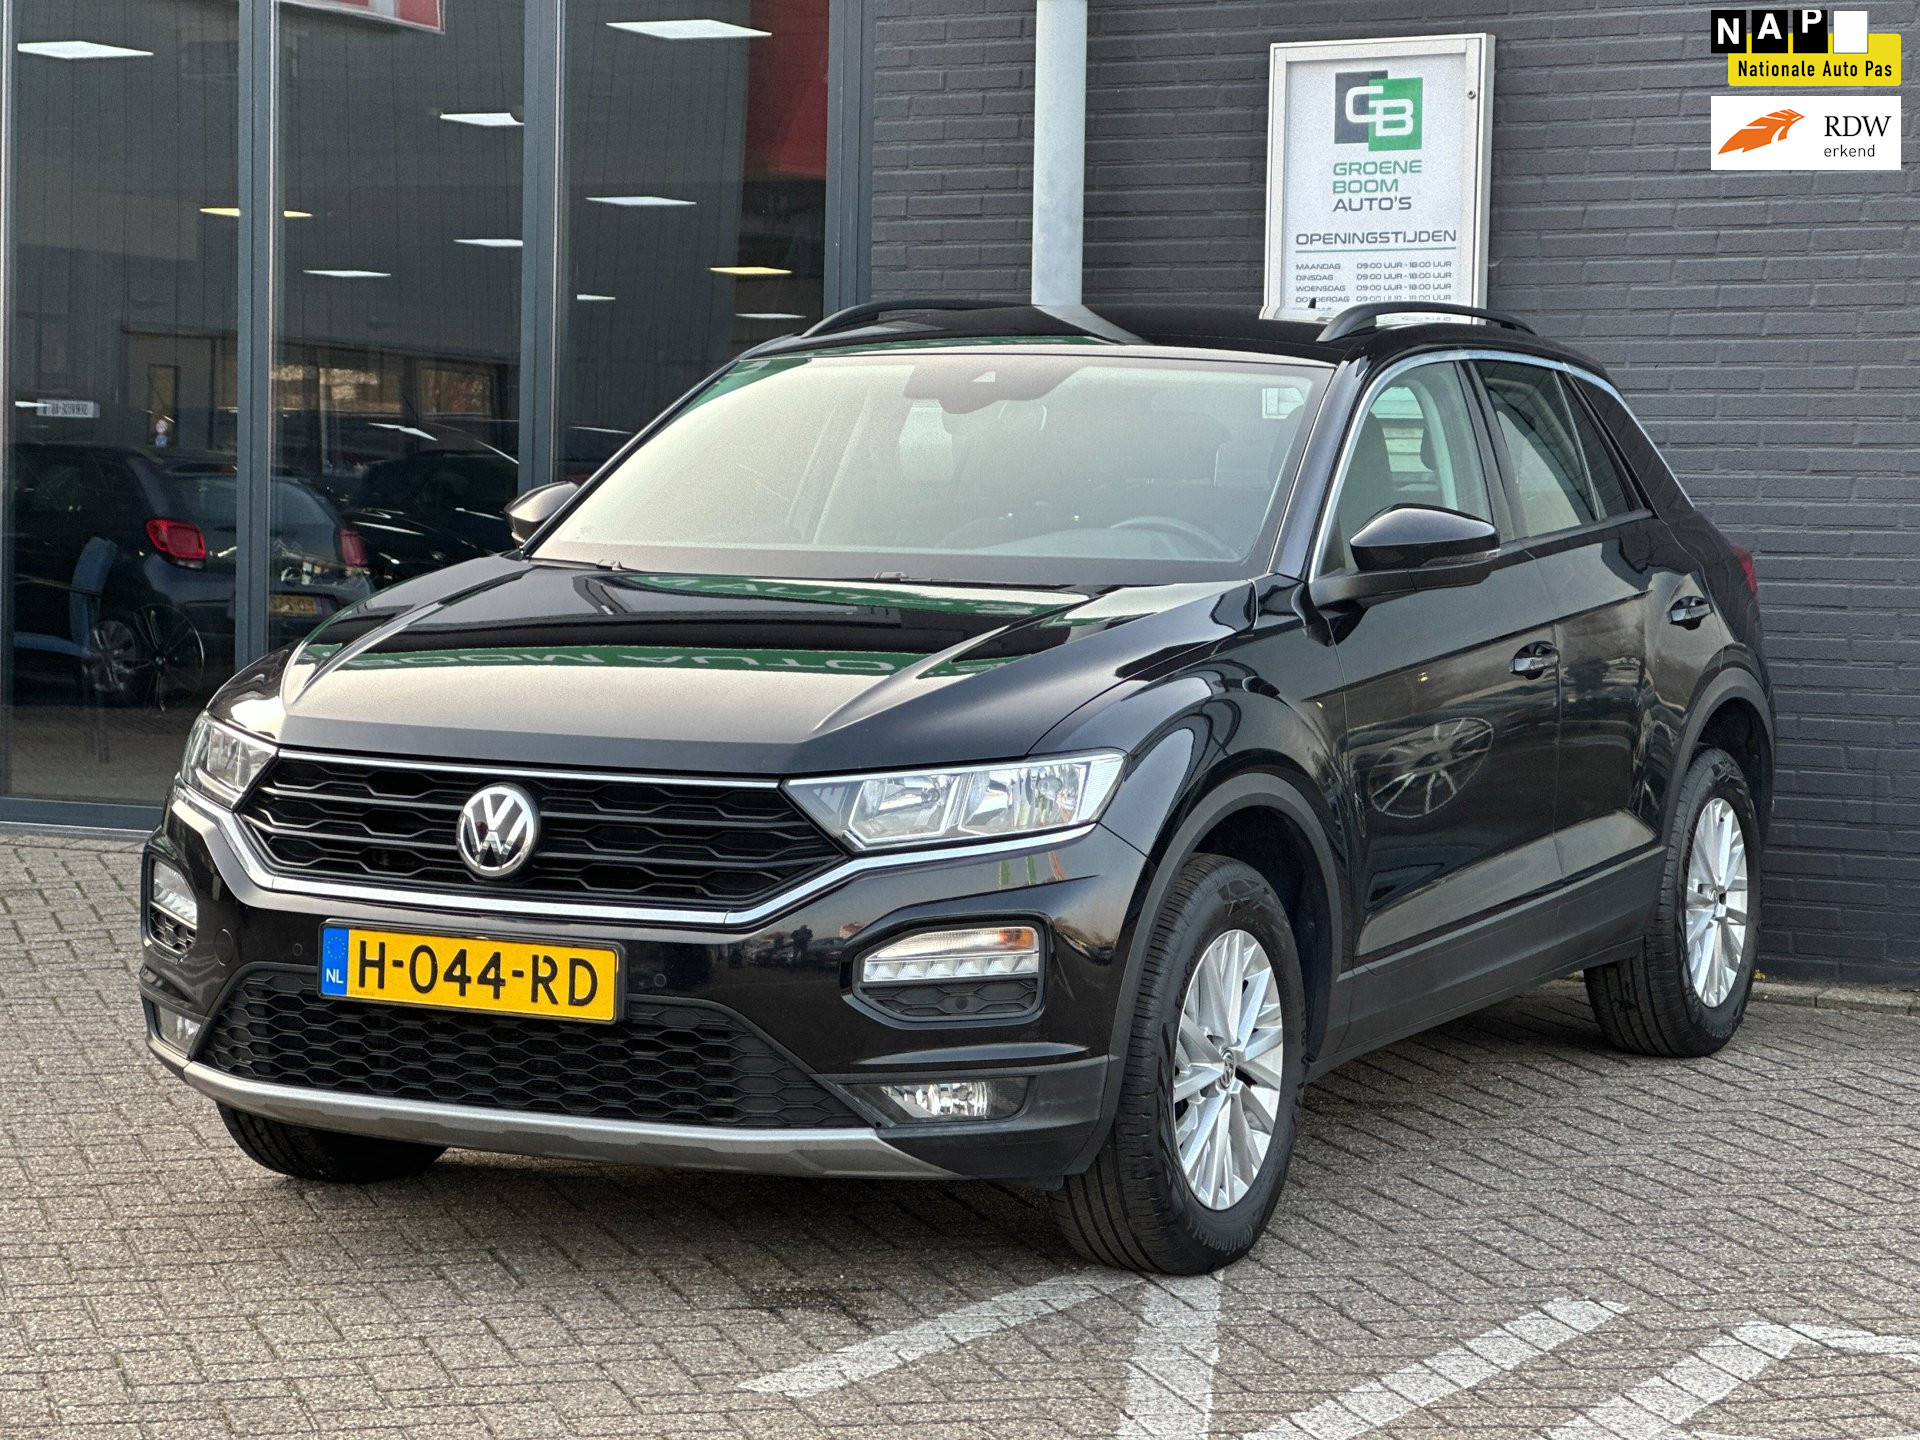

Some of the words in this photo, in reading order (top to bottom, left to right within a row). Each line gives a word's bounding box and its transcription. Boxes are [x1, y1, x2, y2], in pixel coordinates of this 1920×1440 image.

[1333, 159, 1422, 176] GROENE
[1332, 178, 1399, 194] BOOM
[1332, 196, 1412, 212] AUTO'S
[1295, 229, 1456, 246] OPENINGSTIJDEN
[326, 967, 344, 984] NL
[358, 940, 598, 1007] H-044-RD
